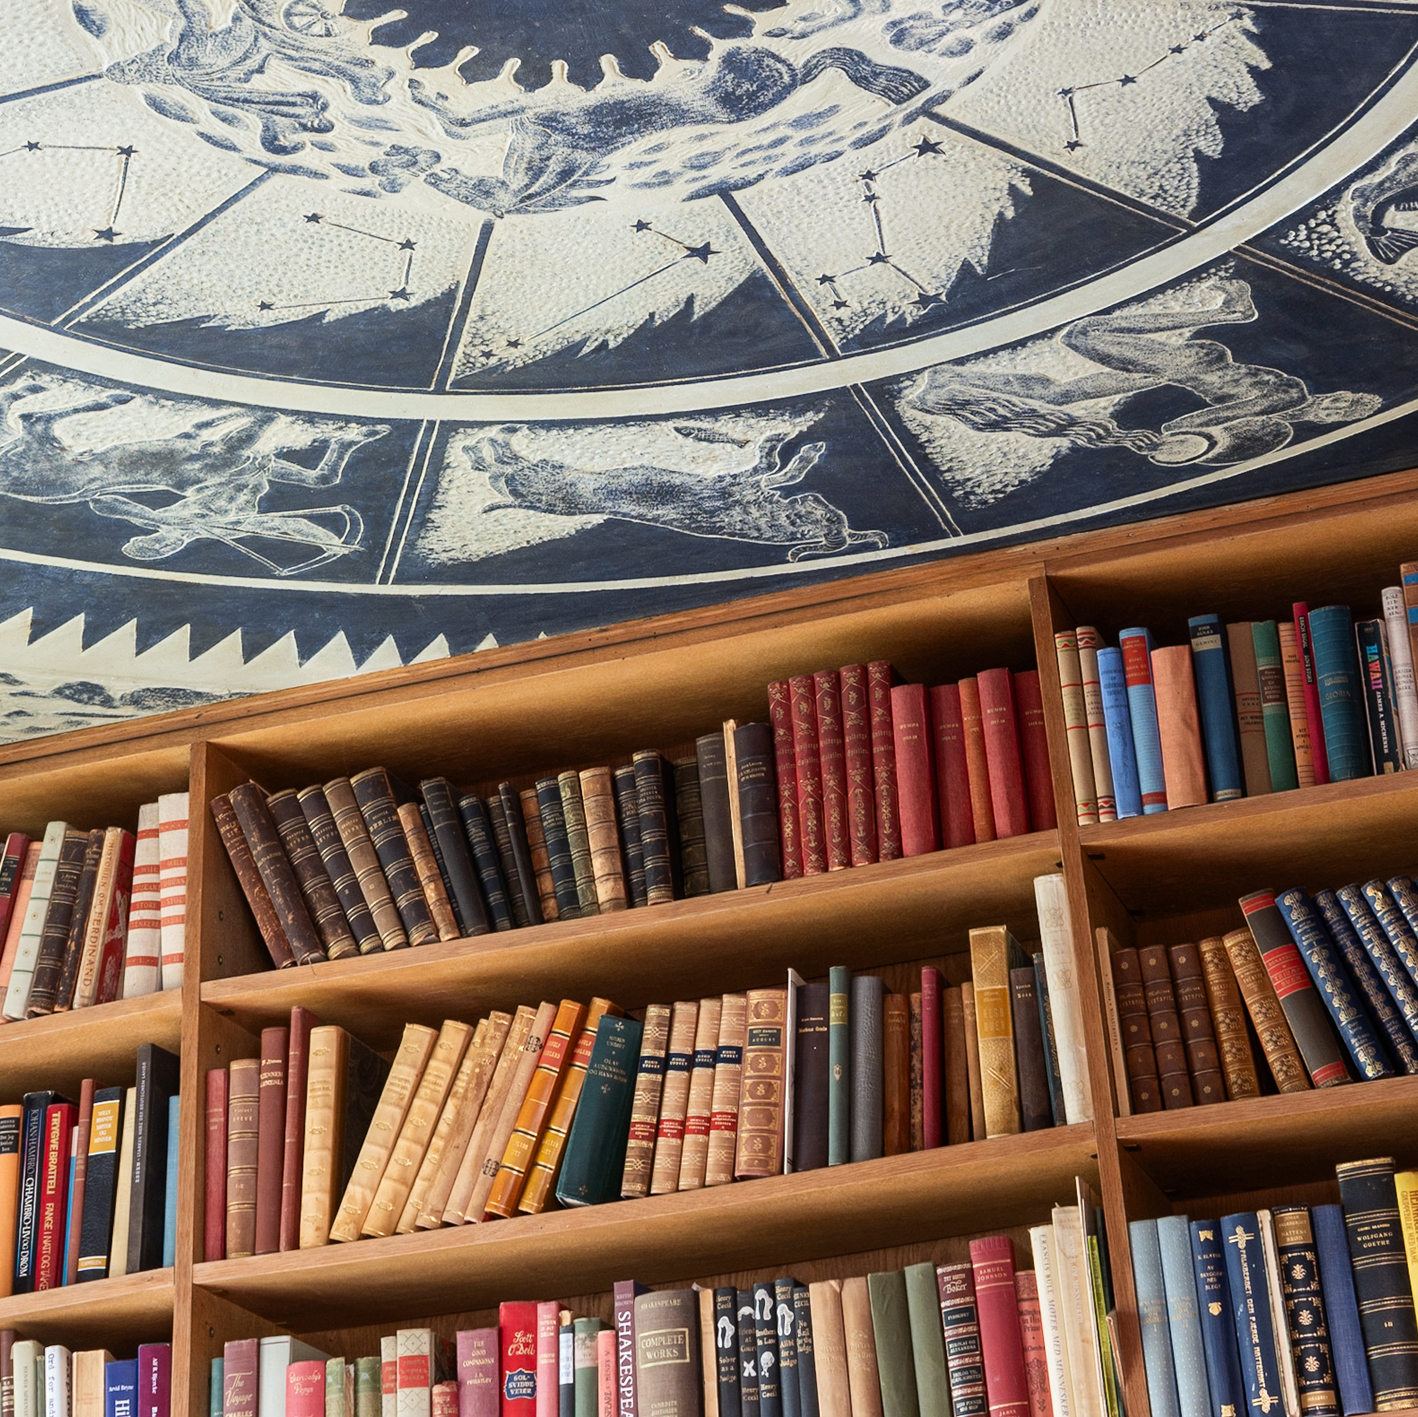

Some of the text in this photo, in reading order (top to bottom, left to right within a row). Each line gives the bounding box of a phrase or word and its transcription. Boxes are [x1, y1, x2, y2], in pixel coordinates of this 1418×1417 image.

[1356, 1231, 1394, 1242] WOLFGANG
[1362, 1239, 1390, 1249] GOETHE
[511, 1330, 534, 1344] Scott
[641, 1334, 684, 1349] COMPLETE
[646, 1348, 679, 1360] WORKS
